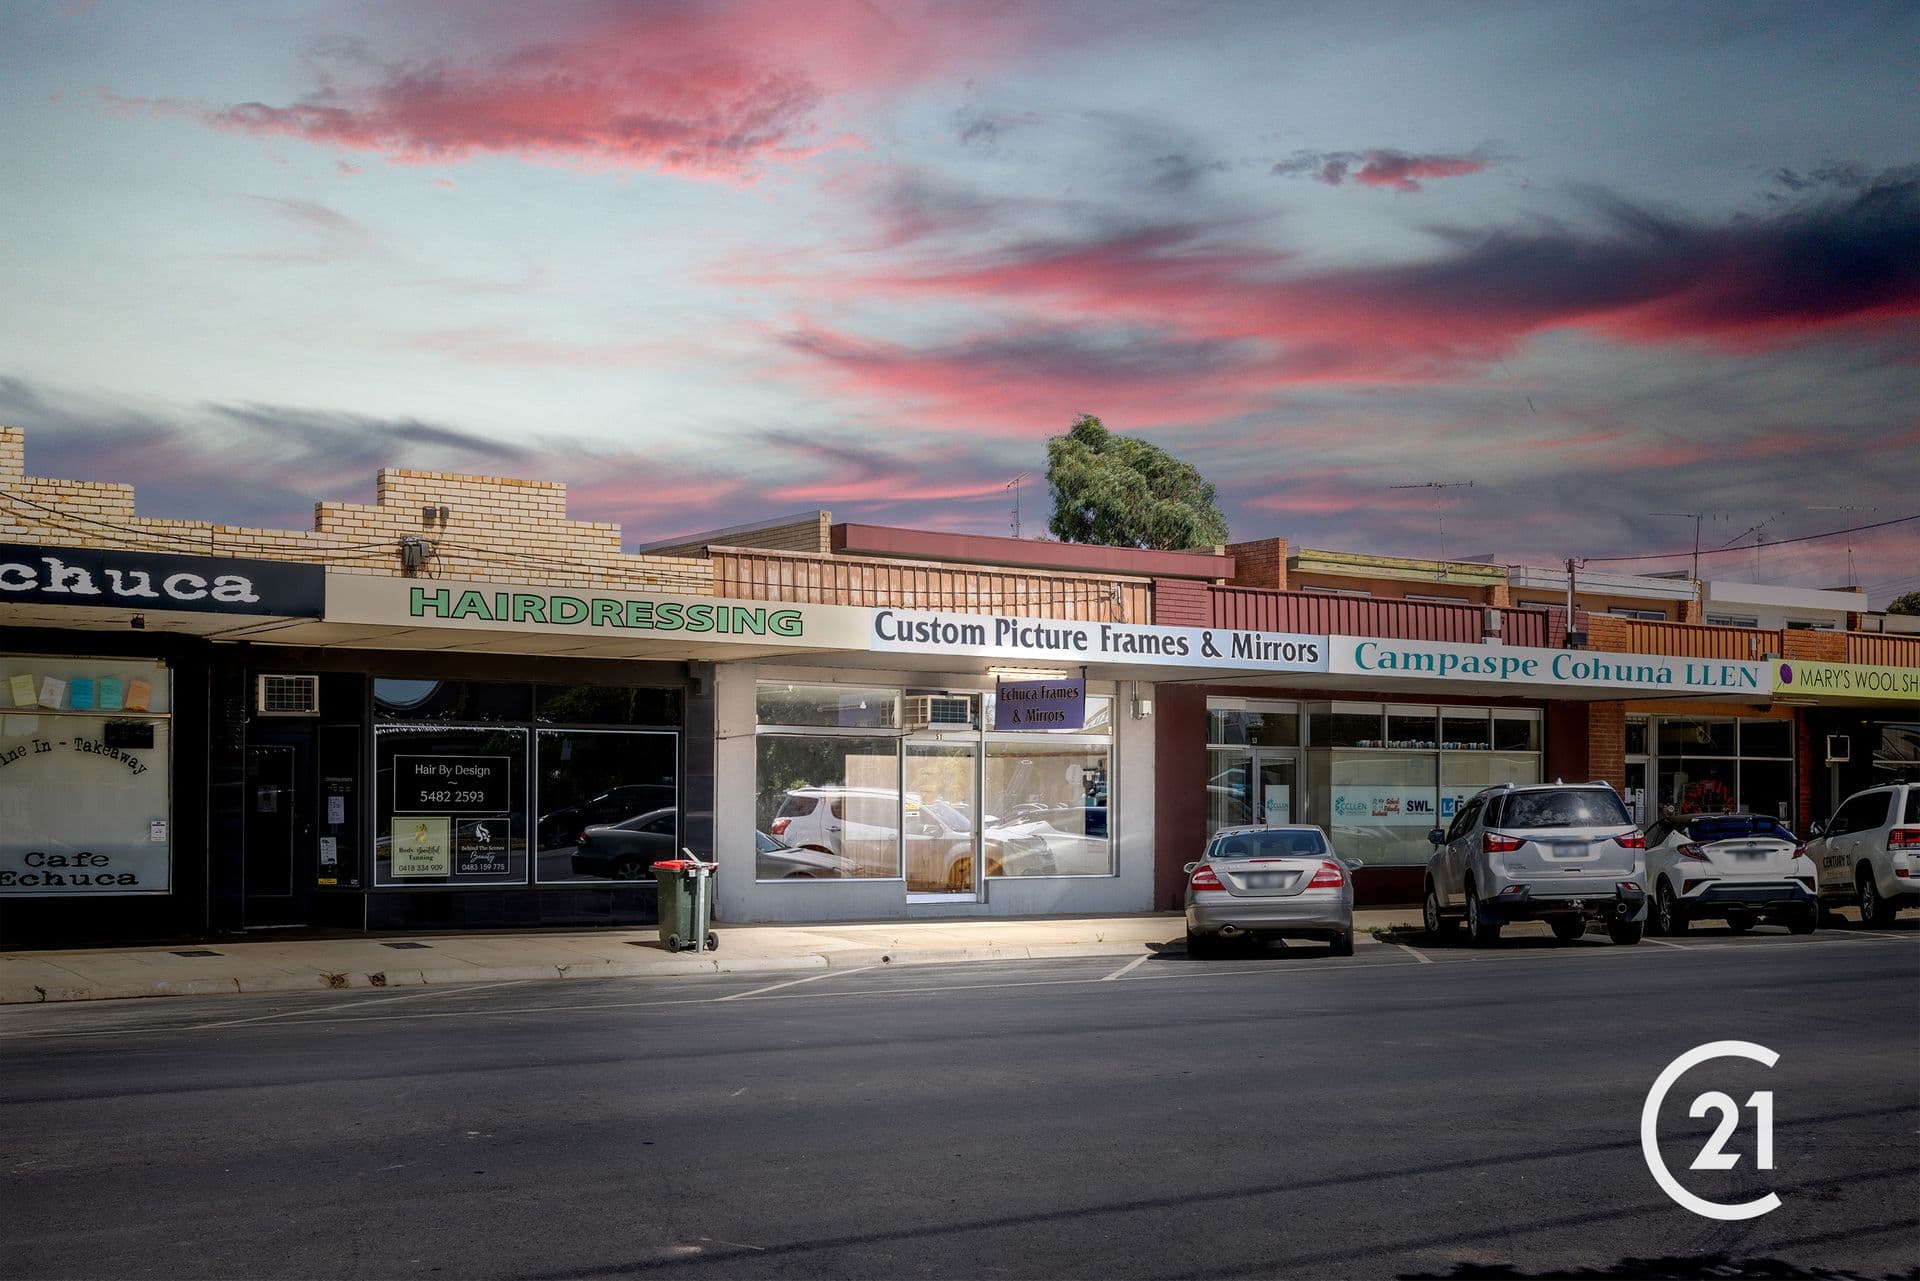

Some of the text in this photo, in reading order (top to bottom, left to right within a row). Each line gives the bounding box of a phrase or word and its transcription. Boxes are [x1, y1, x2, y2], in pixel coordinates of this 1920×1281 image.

[410, 587, 803, 637] HAIRDRESSING
[874, 610, 1319, 662] Custom Picture Frames & Mirrors
[1354, 642, 1759, 688] Campaspe Cohuna LLEN
[1800, 668, 1851, 689] MARY'S
[1855, 671, 1898, 692] WOOL
[1001, 685, 1079, 701] Echuca Frames
[1013, 708, 1065, 723] & Mirrors
[32, 739, 52, 754] In
[74, 737, 147, 775] Takeaway
[415, 764, 491, 778] Hair By Design
[420, 790, 485, 802] 5482 2593
[24, 851, 110, 868] Cafe
[0, 871, 139, 887] Echuca
